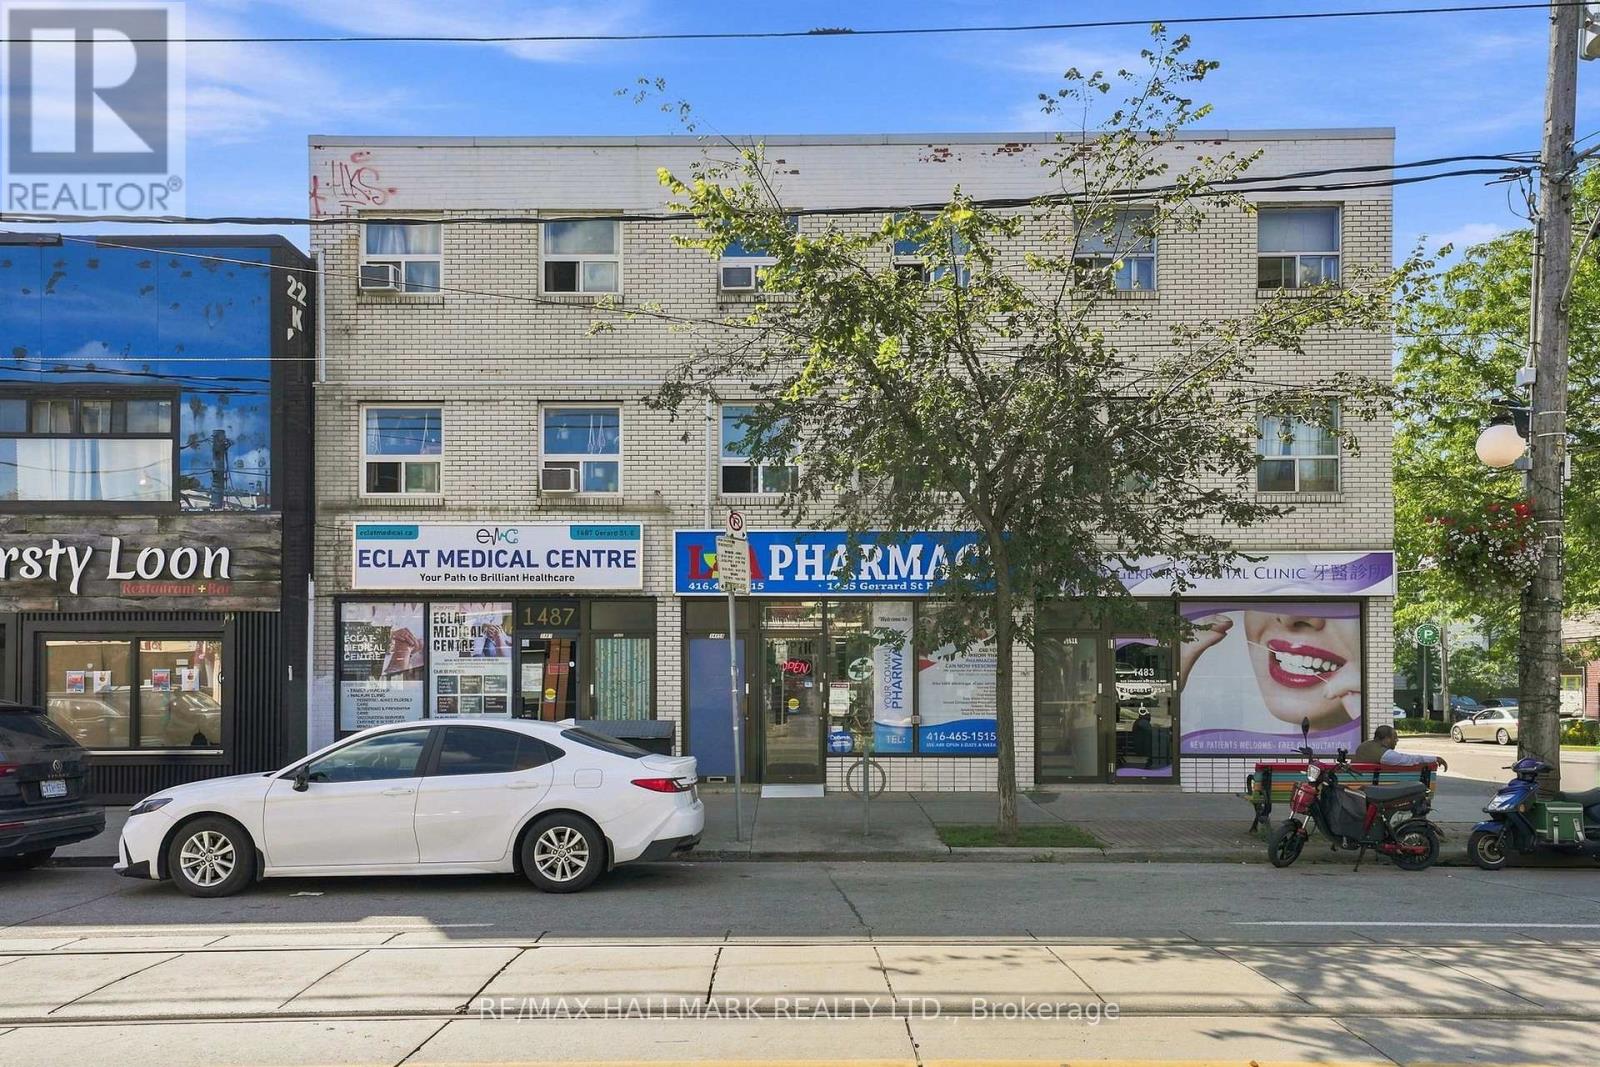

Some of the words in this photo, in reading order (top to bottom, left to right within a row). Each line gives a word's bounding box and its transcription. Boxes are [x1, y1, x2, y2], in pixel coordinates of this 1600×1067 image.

[106, 537, 230, 581] Loon
[358, 549, 430, 568] ECLAT
[437, 549, 539, 568] MEDICAL
[546, 549, 637, 568] CENTRE
[420, 573, 441, 582] Your
[444, 573, 466, 582] Path
[468, 573, 478, 582] to
[480, 573, 520, 582] Brilliant
[522, 573, 575, 582] Healthcare
[1254, 566, 1306, 580] CLINIC
[122, 582, 195, 595] Restaurant
[859, 582, 907, 591] Gerrard
[910, 582, 924, 590] St
[433, 611, 467, 624] ECLAT
[523, 607, 576, 626] 1487
[433, 626, 483, 638] MEDICAL
[433, 639, 475, 652] CENTRE
[783, 661, 809, 673] OPEN
[1134, 668, 1155, 677] 1483
[883, 685, 892, 710] YOUR
[886, 735, 906, 744] TEL:
[926, 731, 997, 741] 416-465-1515
[1190, 741, 1204, 749] NEW
[1206, 741, 1237, 749] PATIENTS
[1239, 741, 1272, 749] WELCOME
